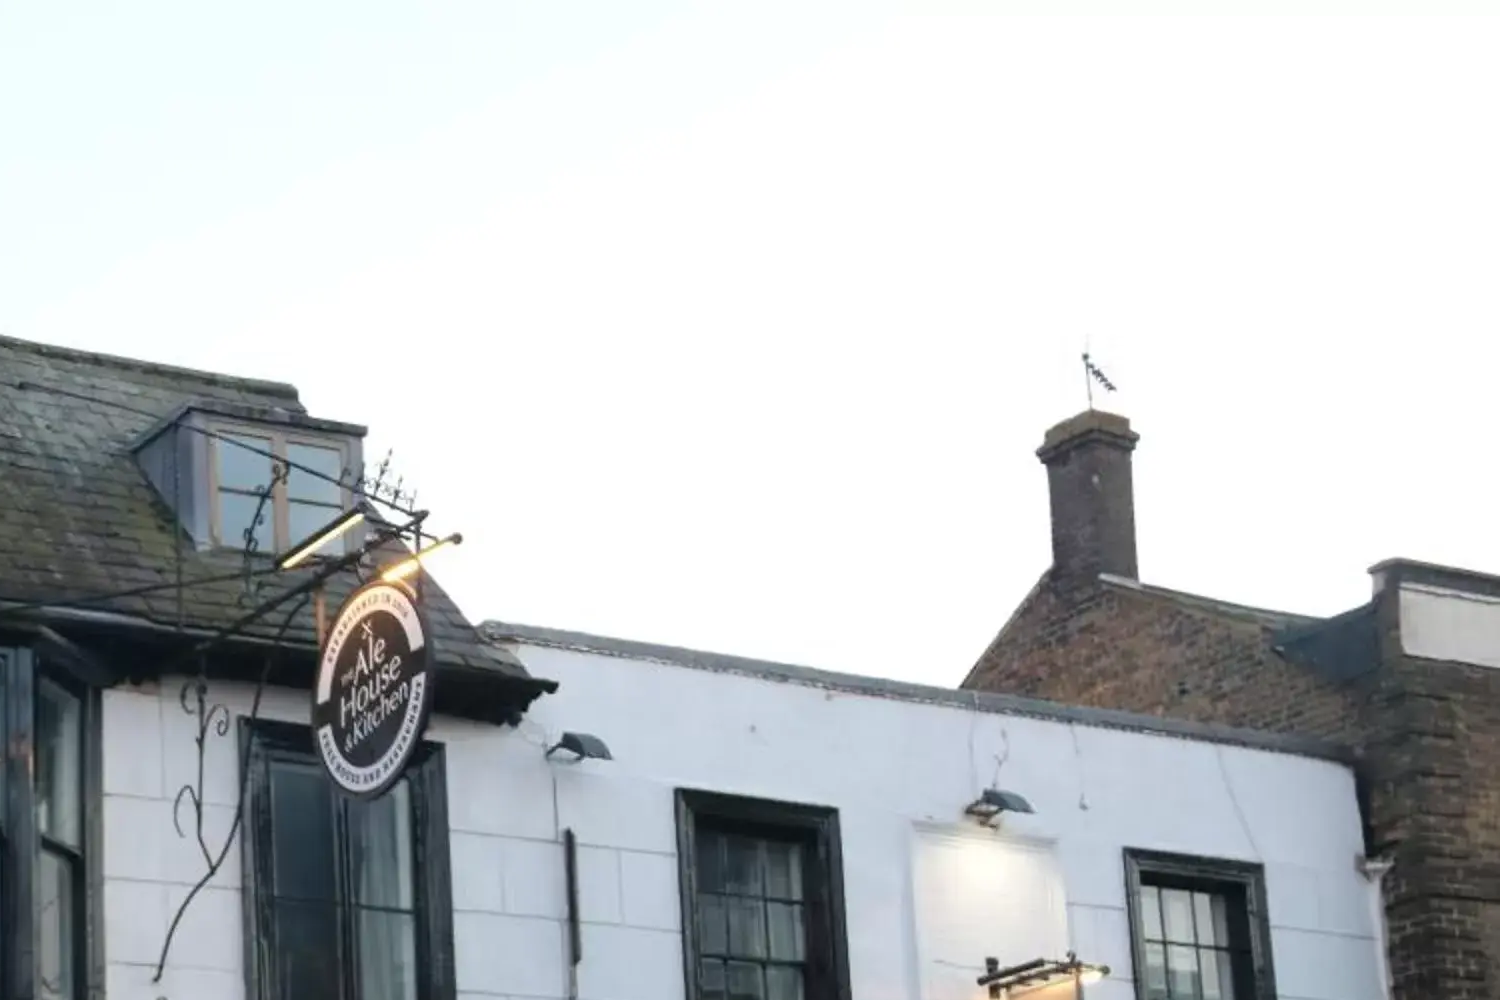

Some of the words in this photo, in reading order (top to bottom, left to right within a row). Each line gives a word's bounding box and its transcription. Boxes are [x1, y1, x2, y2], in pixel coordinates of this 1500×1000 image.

[341, 655, 401, 729] House
[353, 634, 387, 686] Ale
[353, 681, 409, 745] Kitchen
